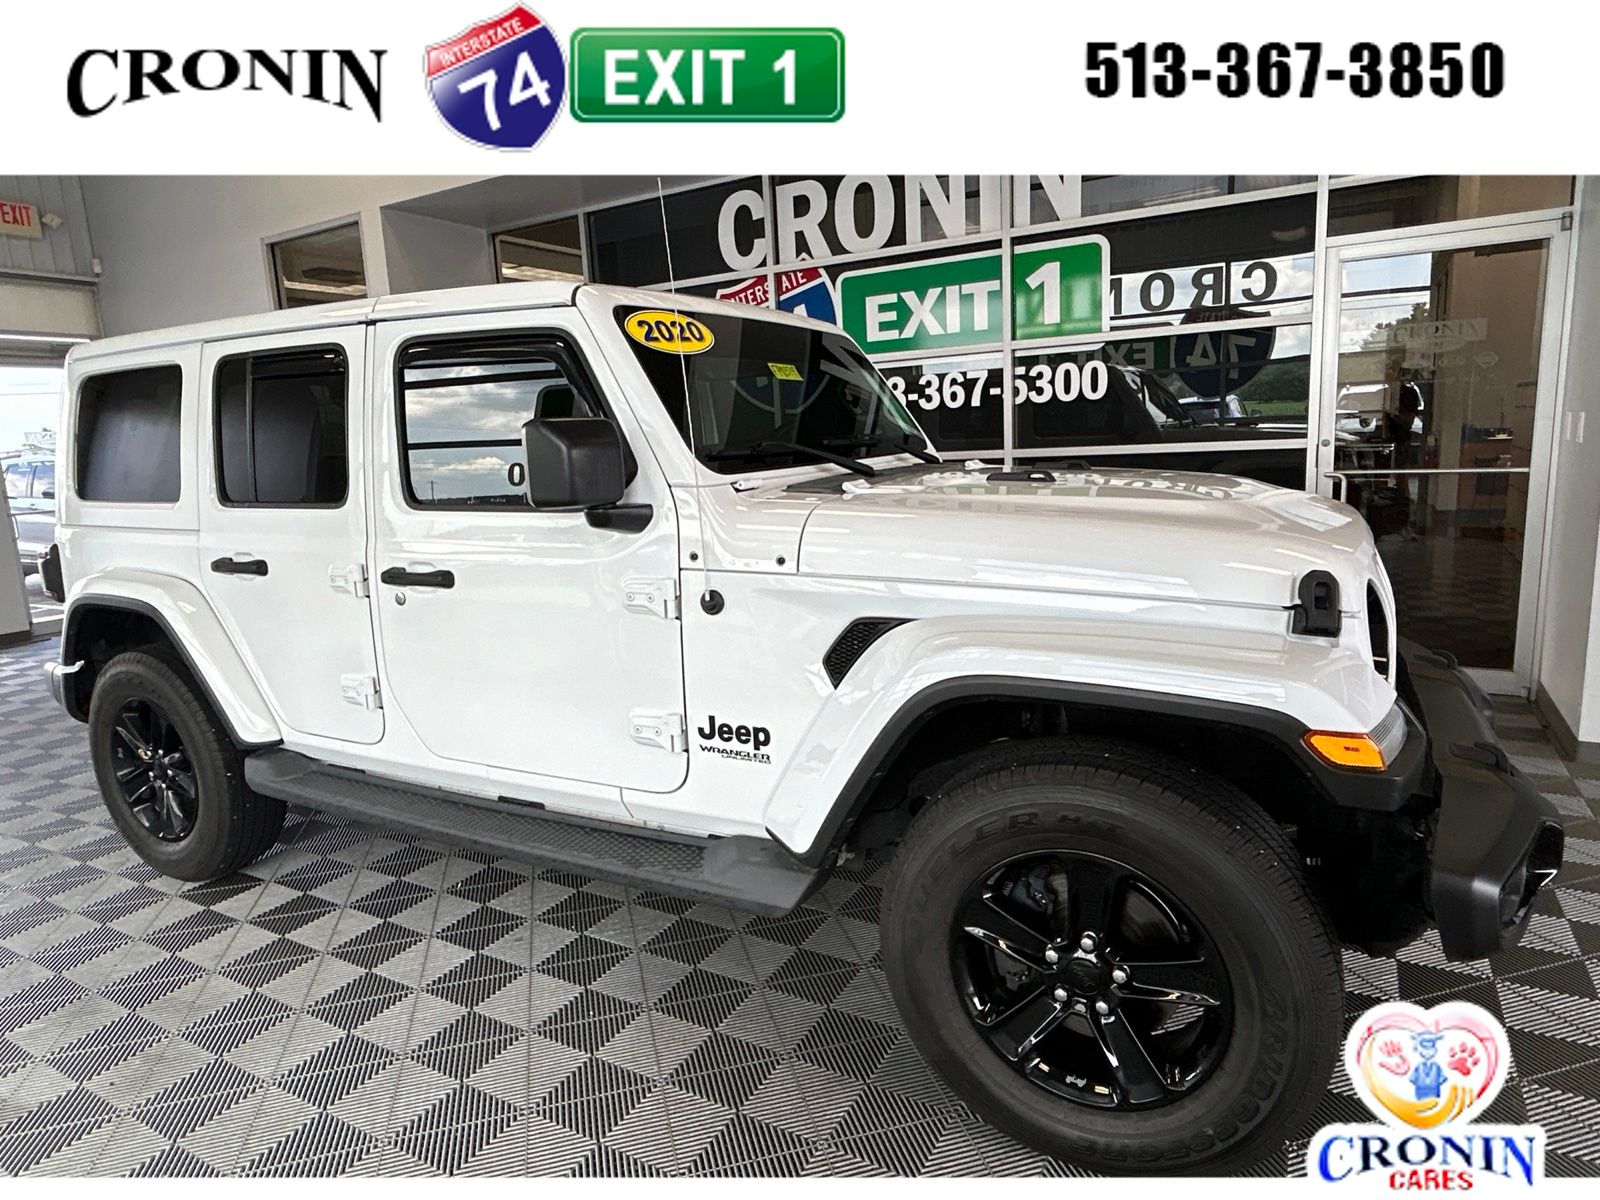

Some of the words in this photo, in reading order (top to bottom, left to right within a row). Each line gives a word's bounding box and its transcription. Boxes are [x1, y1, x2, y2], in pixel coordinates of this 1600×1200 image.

[0, 203, 32, 227] EXIT
[718, 174, 1082, 271] CRONIN
[865, 279, 1001, 343] EXIT
[1025, 261, 1061, 325] 1
[637, 319, 705, 343] 2020
[697, 715, 771, 751] Jeep
[699, 744, 771, 761] WRANGLER
